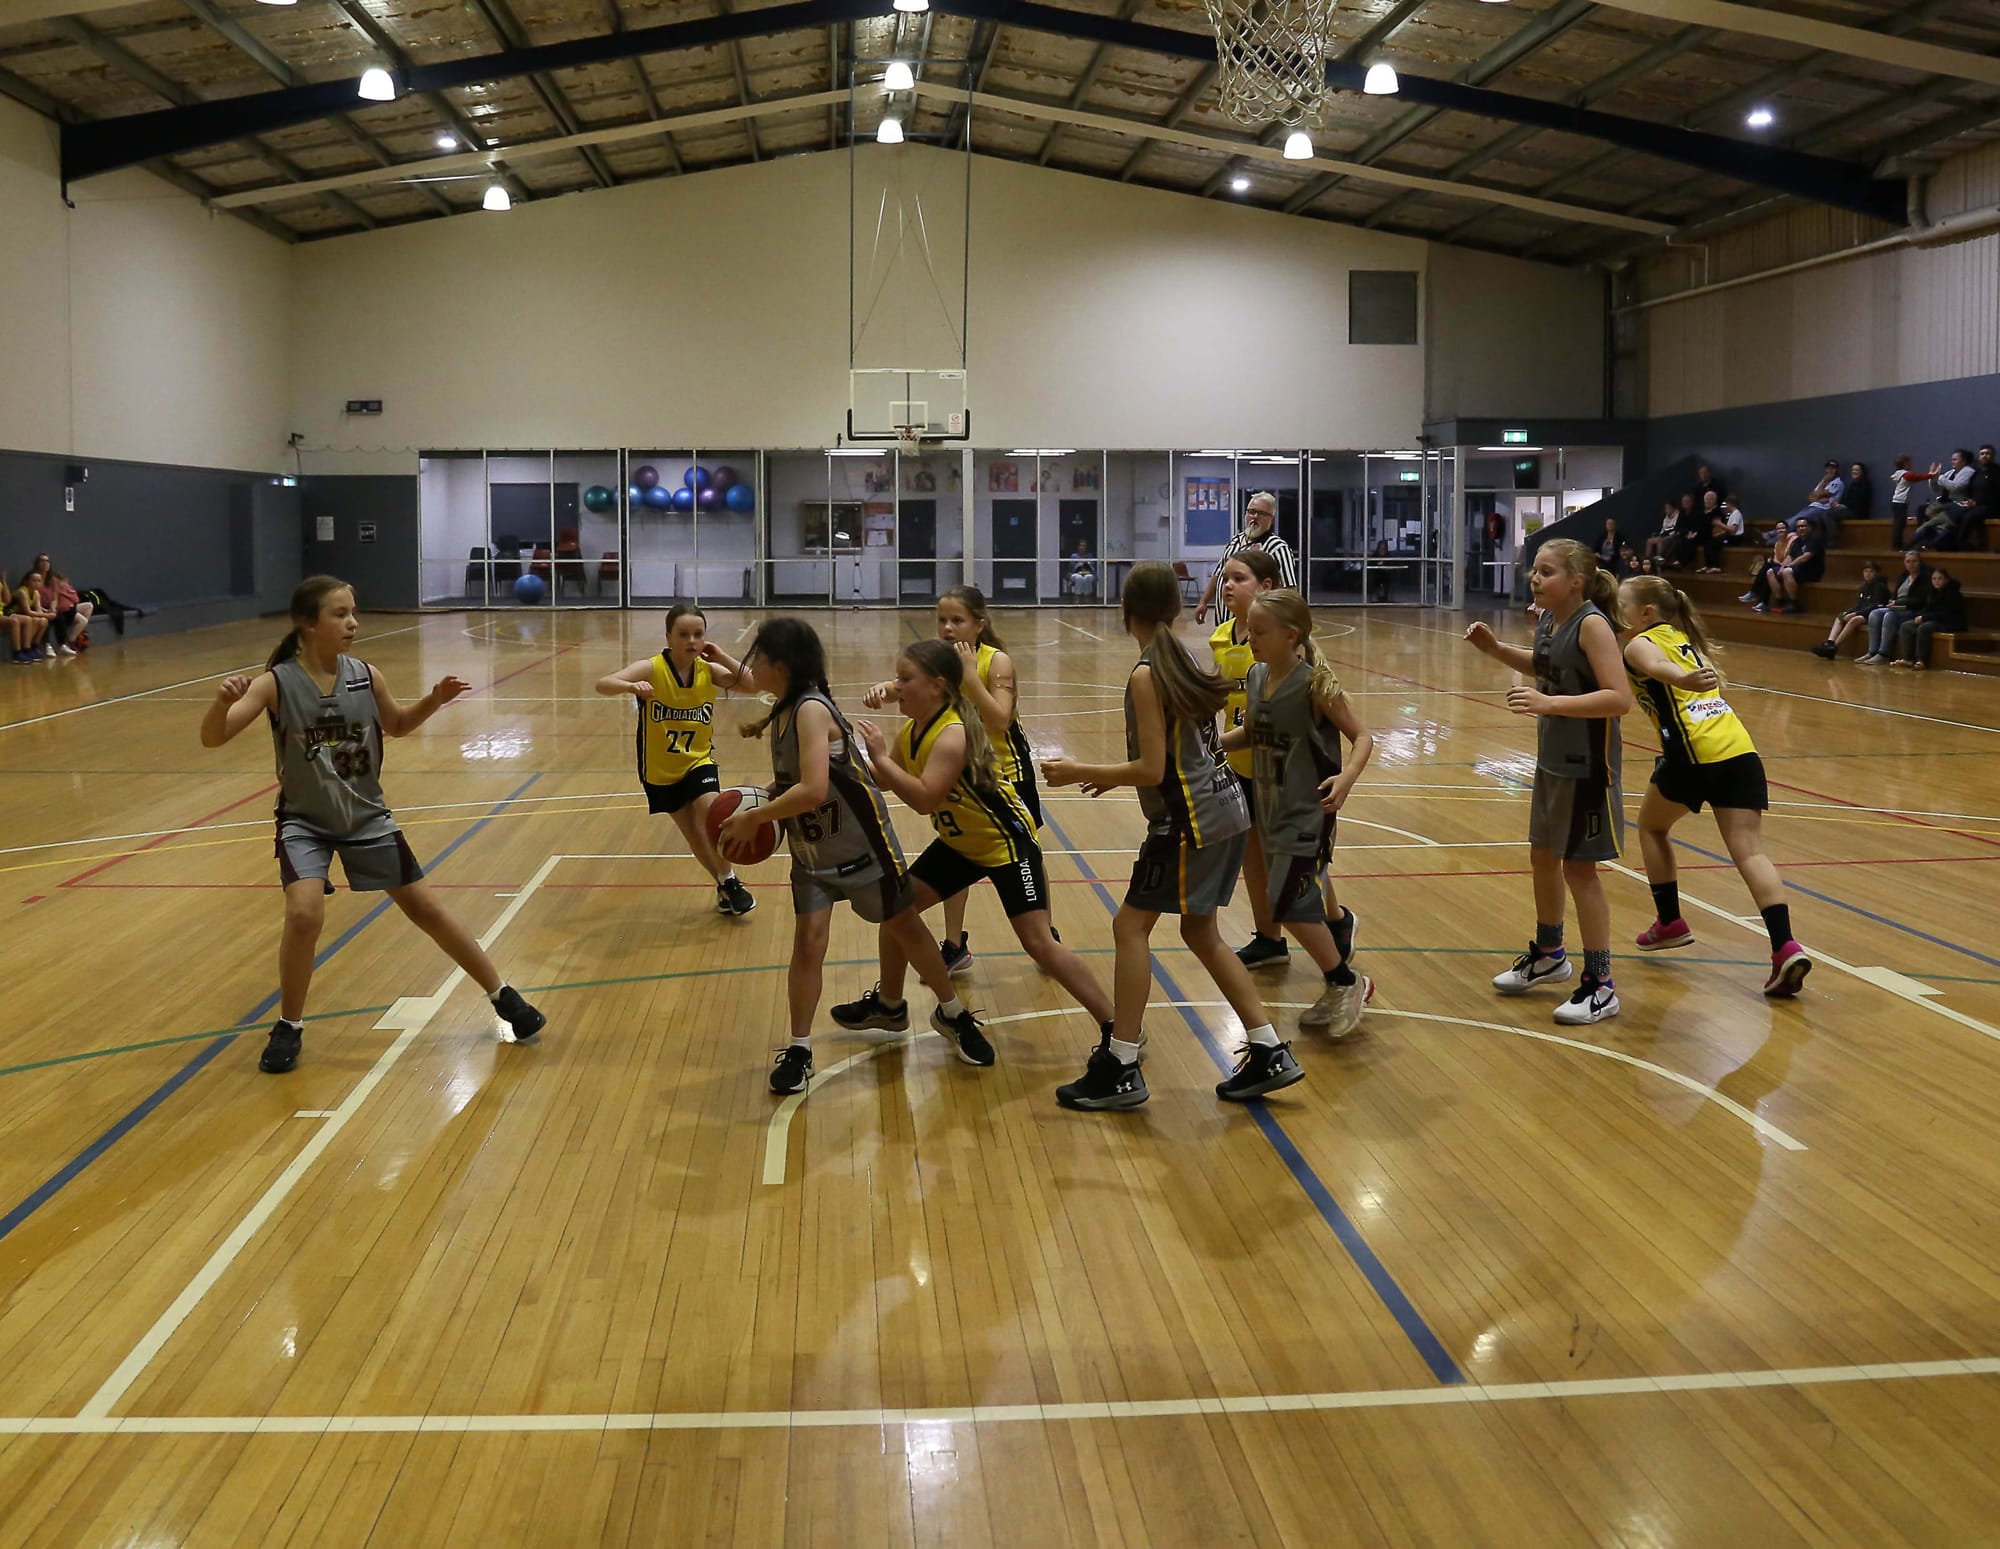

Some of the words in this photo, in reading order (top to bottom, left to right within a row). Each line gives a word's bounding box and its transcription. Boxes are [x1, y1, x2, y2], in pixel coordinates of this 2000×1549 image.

[651, 698, 713, 725] GLADIATORS
[666, 730, 697, 753] 27
[334, 743, 370, 780] 33
[800, 799, 841, 845] 67
[1019, 857, 1037, 902] LONSDA
